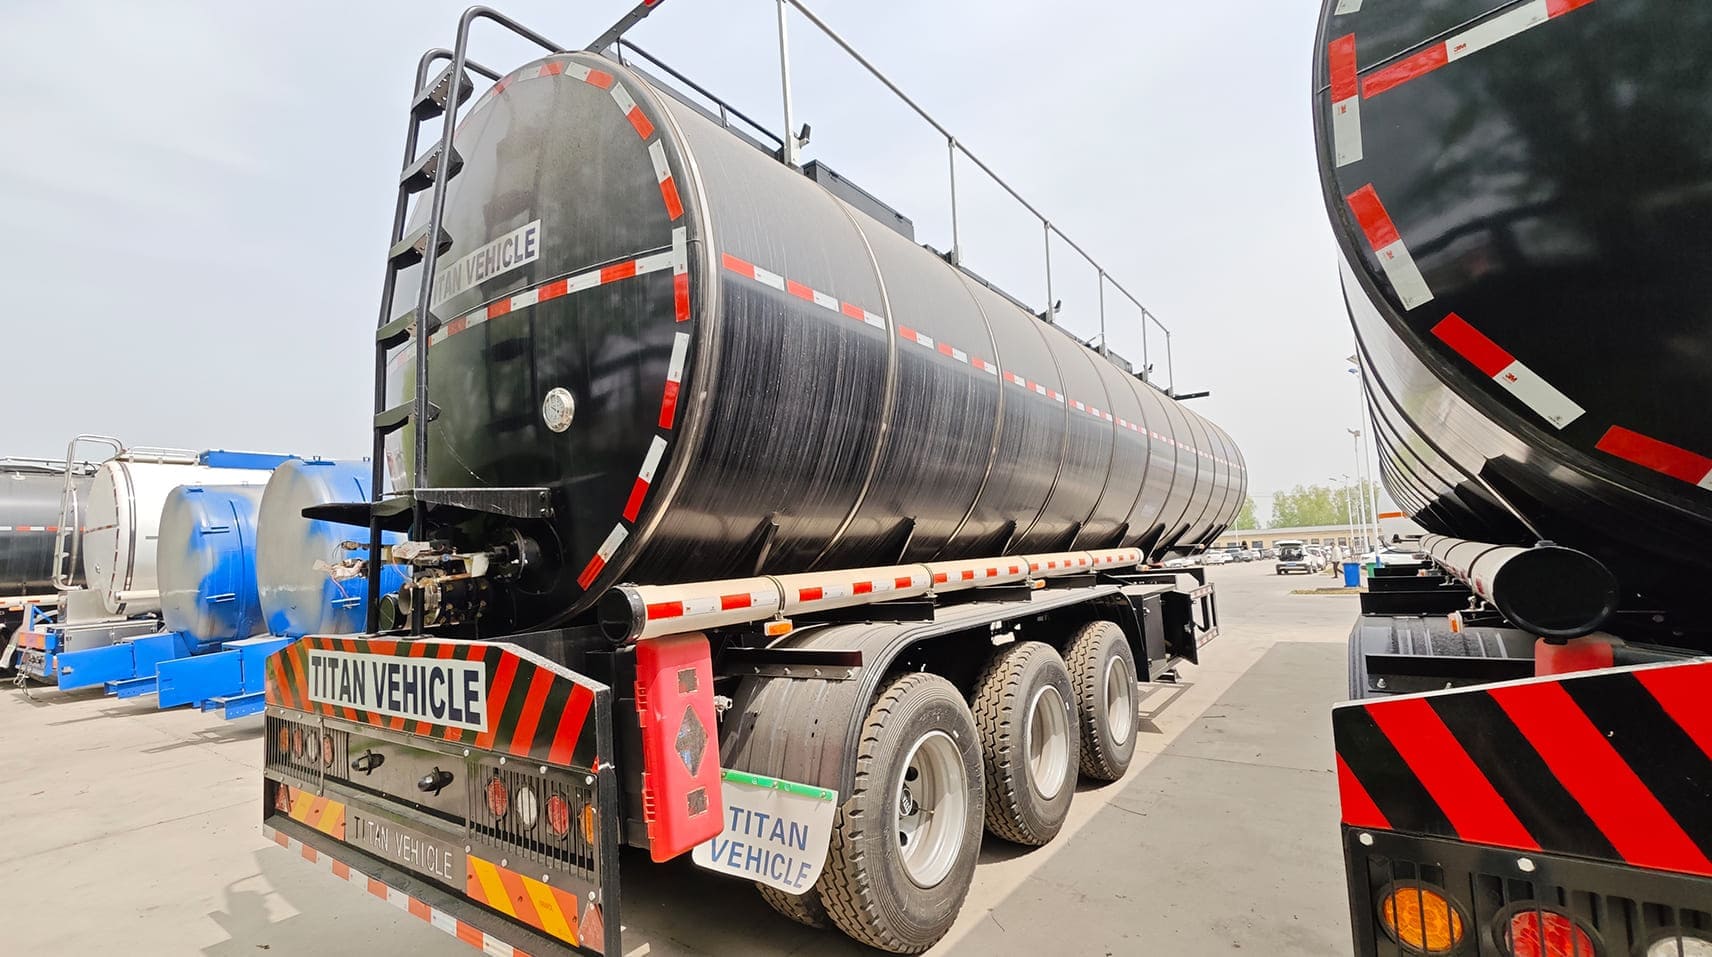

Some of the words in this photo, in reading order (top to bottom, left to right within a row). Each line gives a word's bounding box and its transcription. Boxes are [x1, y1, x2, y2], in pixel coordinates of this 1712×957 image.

[434, 263, 462, 305] ITAN
[466, 228, 536, 285] VEHICLE
[311, 656, 366, 705] TITAN
[372, 662, 481, 725] VEHICLE
[354, 816, 389, 851] TITAN
[396, 831, 453, 880] VEHICLE
[729, 805, 809, 851] TITAN
[711, 838, 812, 889] VEHICLE
